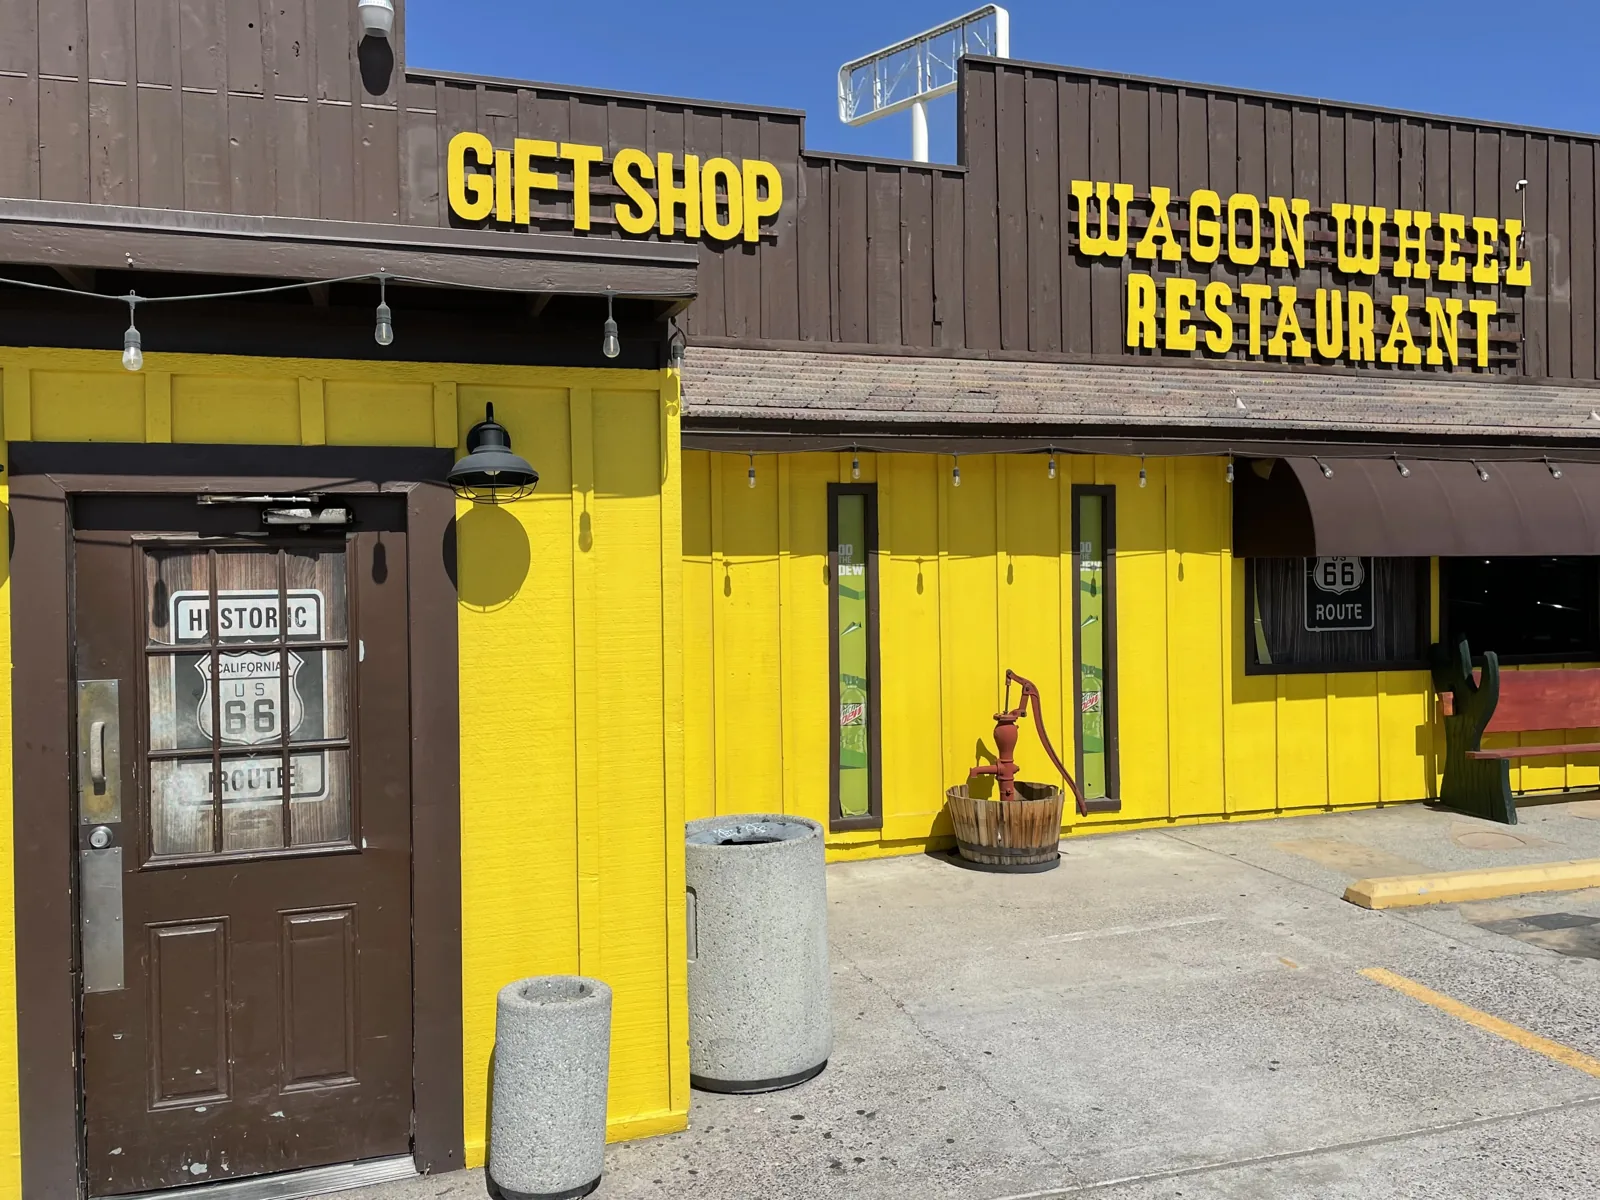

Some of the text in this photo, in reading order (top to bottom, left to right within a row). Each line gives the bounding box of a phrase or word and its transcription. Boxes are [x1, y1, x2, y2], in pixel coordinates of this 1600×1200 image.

[447, 131, 783, 243] GIFT SHOP
[1071, 179, 1532, 287] WAGON WHEEL
[1126, 273, 1497, 368] RESTAURANT
[1324, 562, 1354, 586] 66
[189, 606, 307, 631] HISTORIC
[1316, 603, 1363, 621] ROUTE
[225, 699, 275, 734] 66
[208, 765, 296, 793] ROUTE
